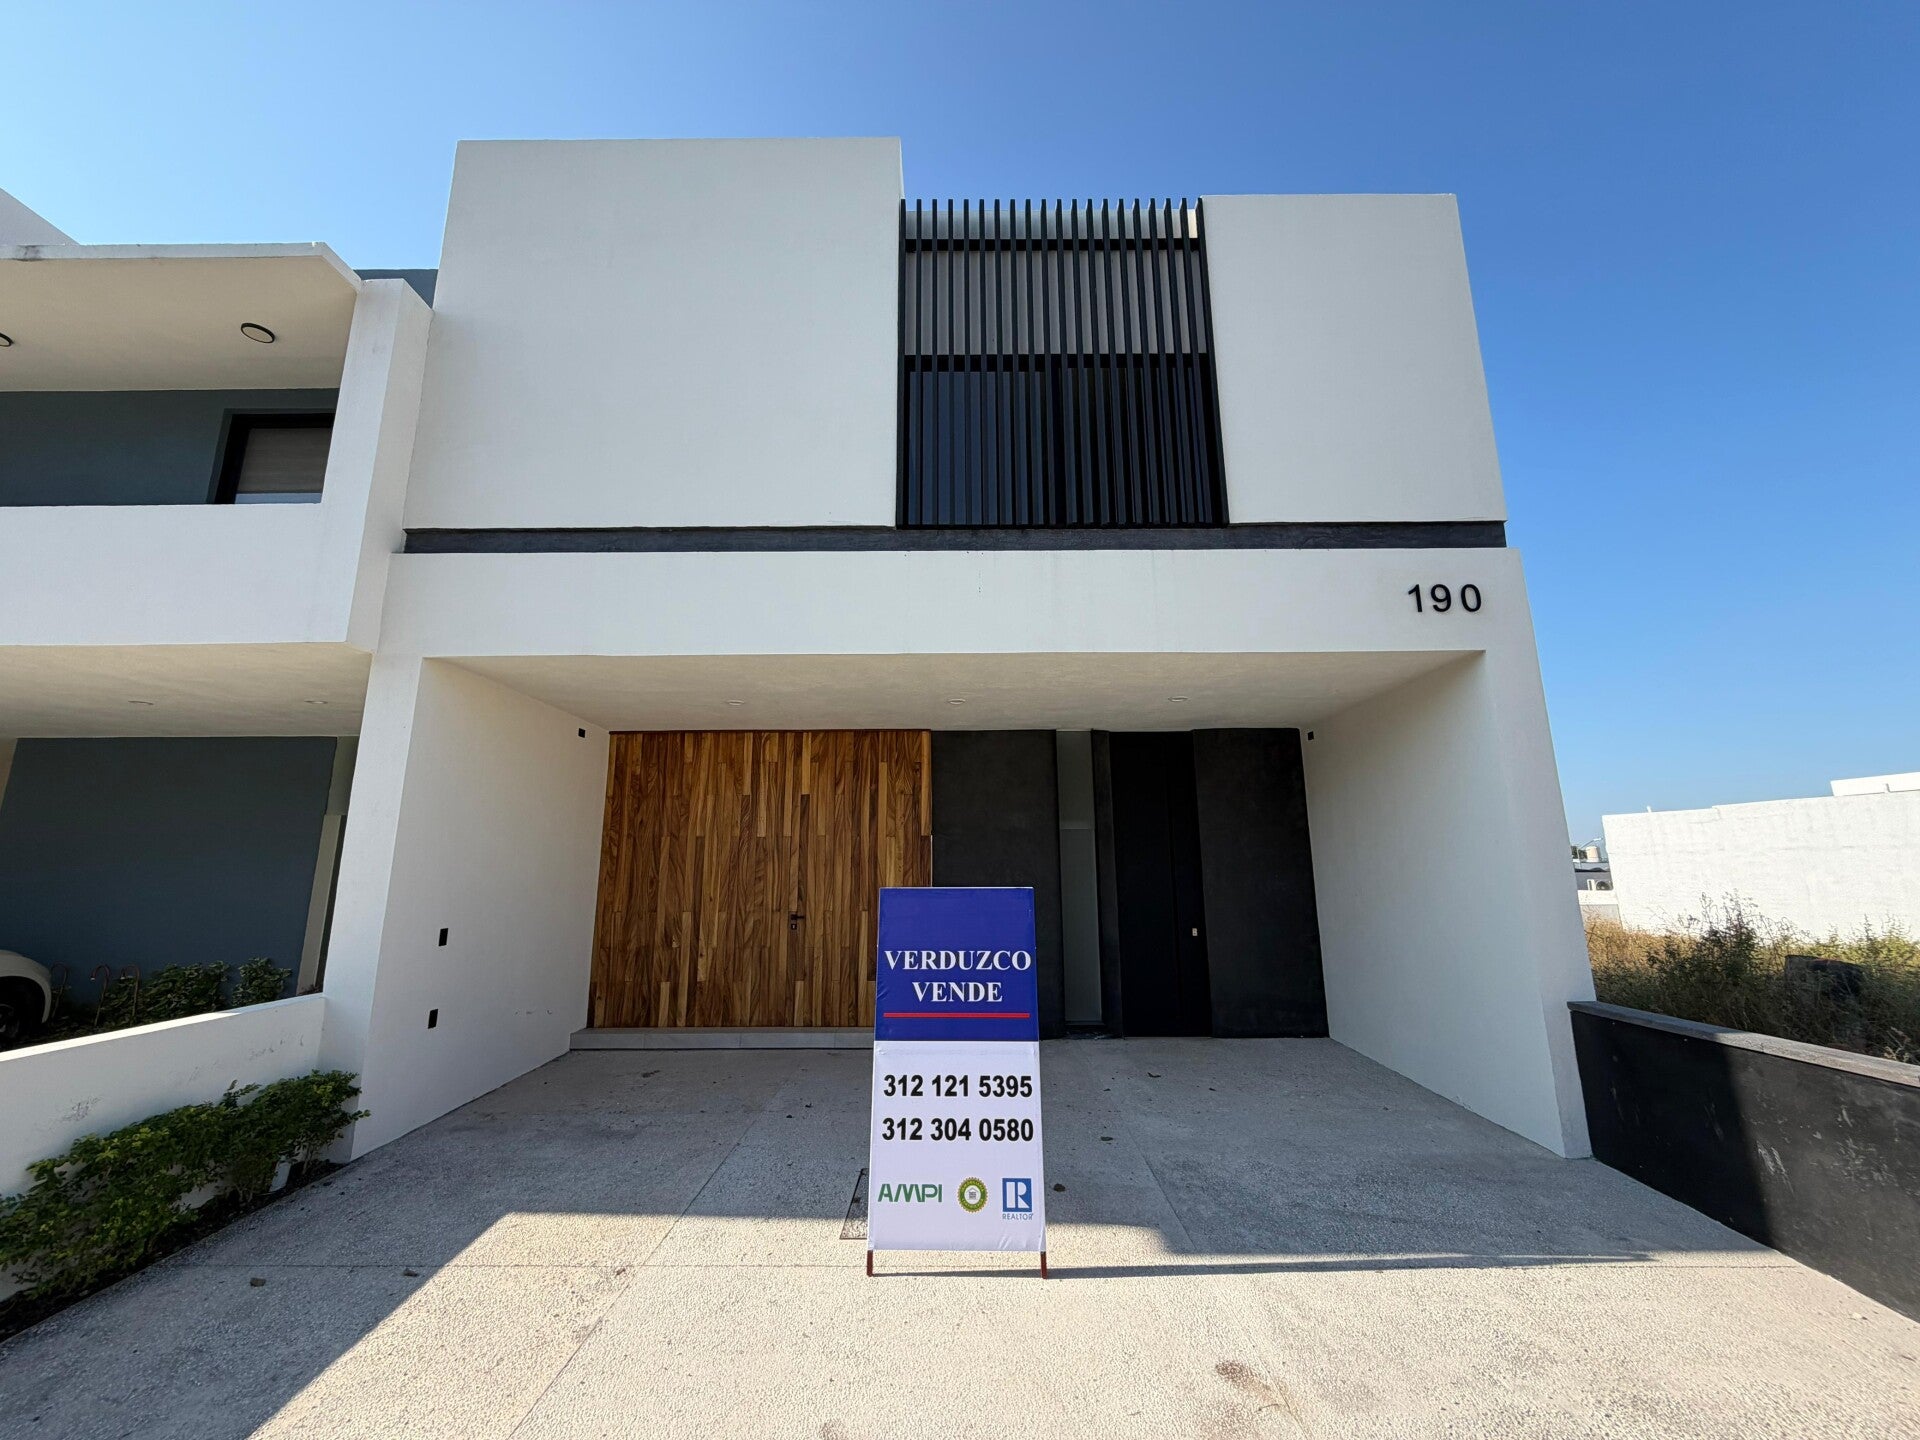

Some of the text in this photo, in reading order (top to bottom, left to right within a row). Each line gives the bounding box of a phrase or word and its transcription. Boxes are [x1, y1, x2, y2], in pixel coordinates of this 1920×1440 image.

[1407, 584, 1482, 612] 190
[884, 950, 1032, 970] VERDUZCO
[912, 981, 1003, 1002] VENDE
[883, 1074, 1033, 1098] 312 121 5395
[882, 1117, 1034, 1142] 312 304 0580
[877, 1183, 943, 1203] AMPI
